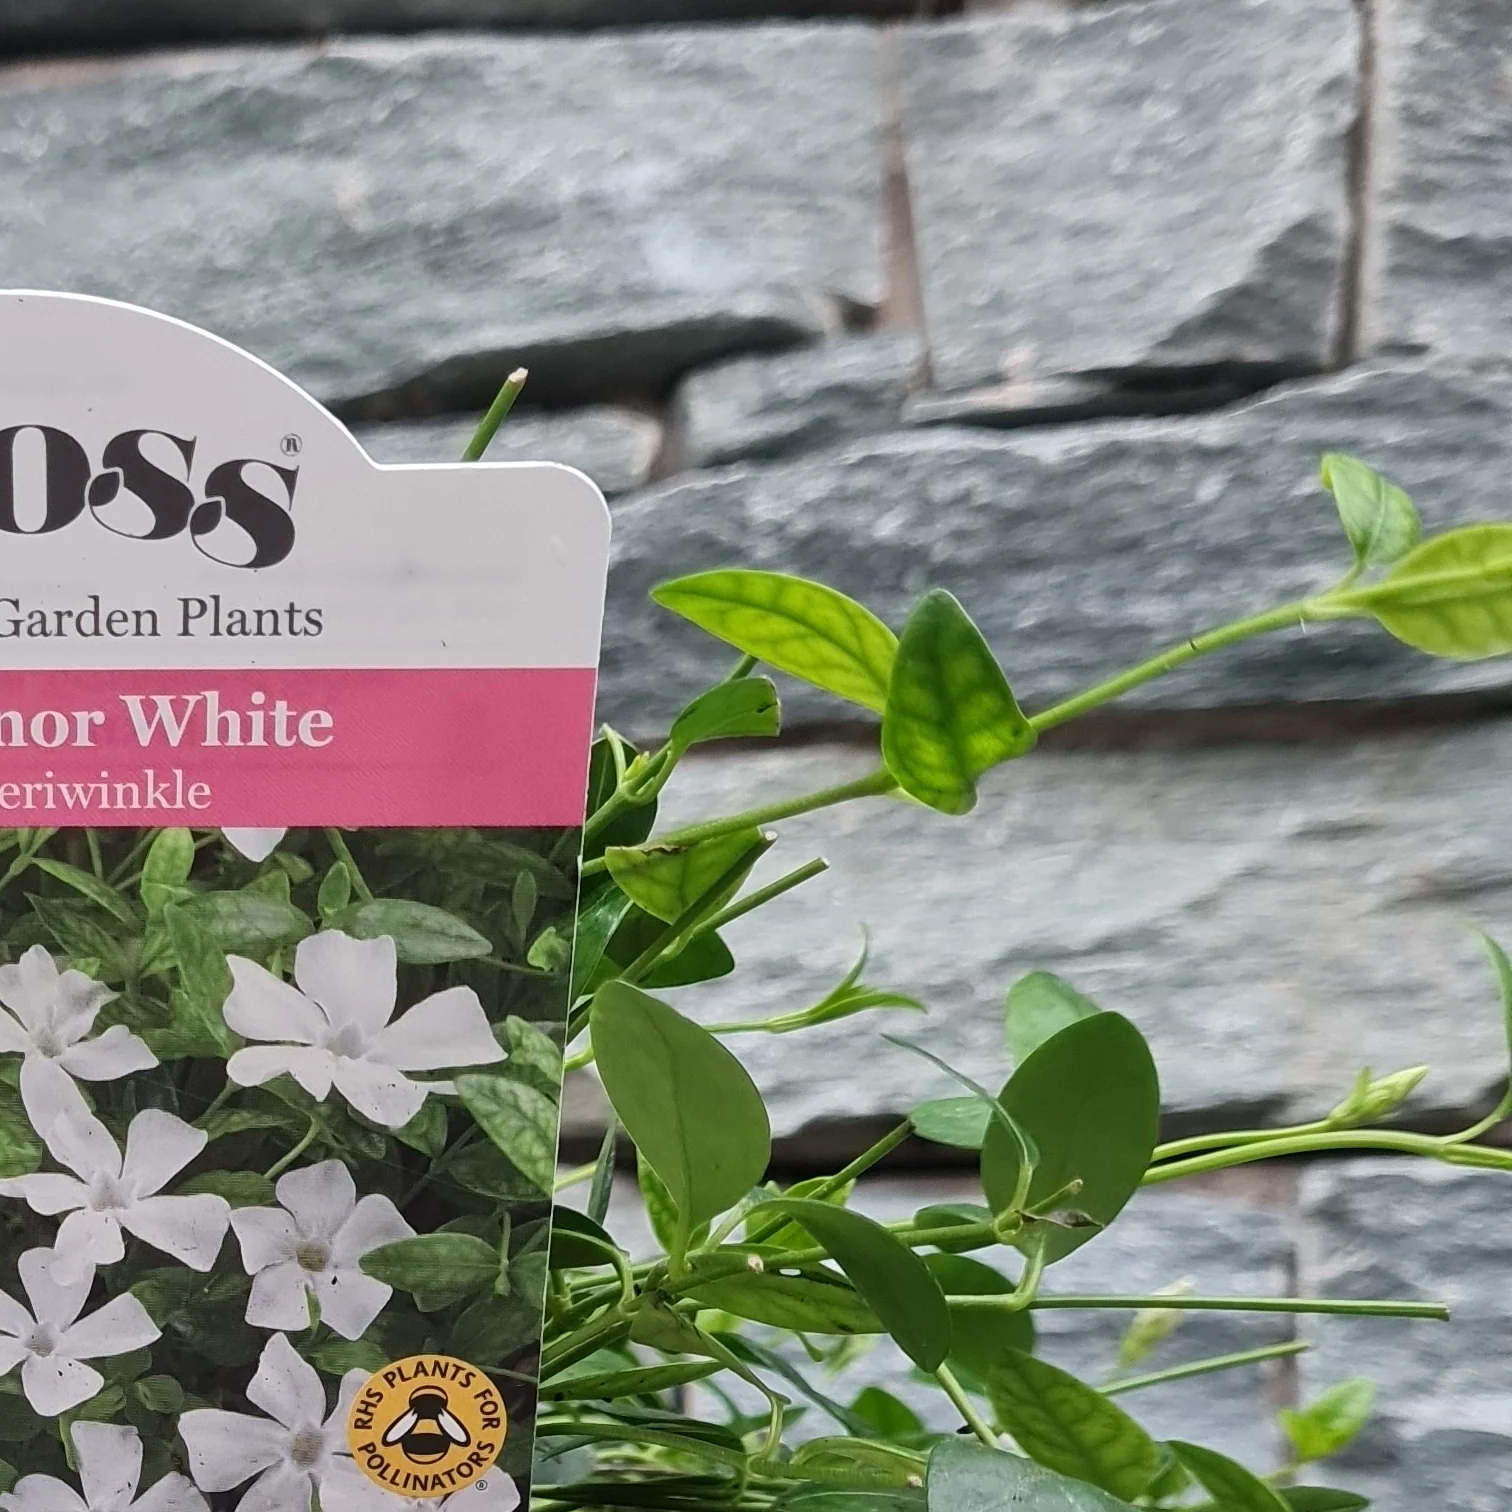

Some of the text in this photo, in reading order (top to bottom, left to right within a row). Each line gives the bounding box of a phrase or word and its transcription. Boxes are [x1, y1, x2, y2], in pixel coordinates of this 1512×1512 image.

[177, 596, 325, 640] Plants
[119, 692, 336, 748] White
[354, 1359, 501, 1431] RHS PLANTS FOR
[356, 1440, 495, 1492] POLLINATORS
